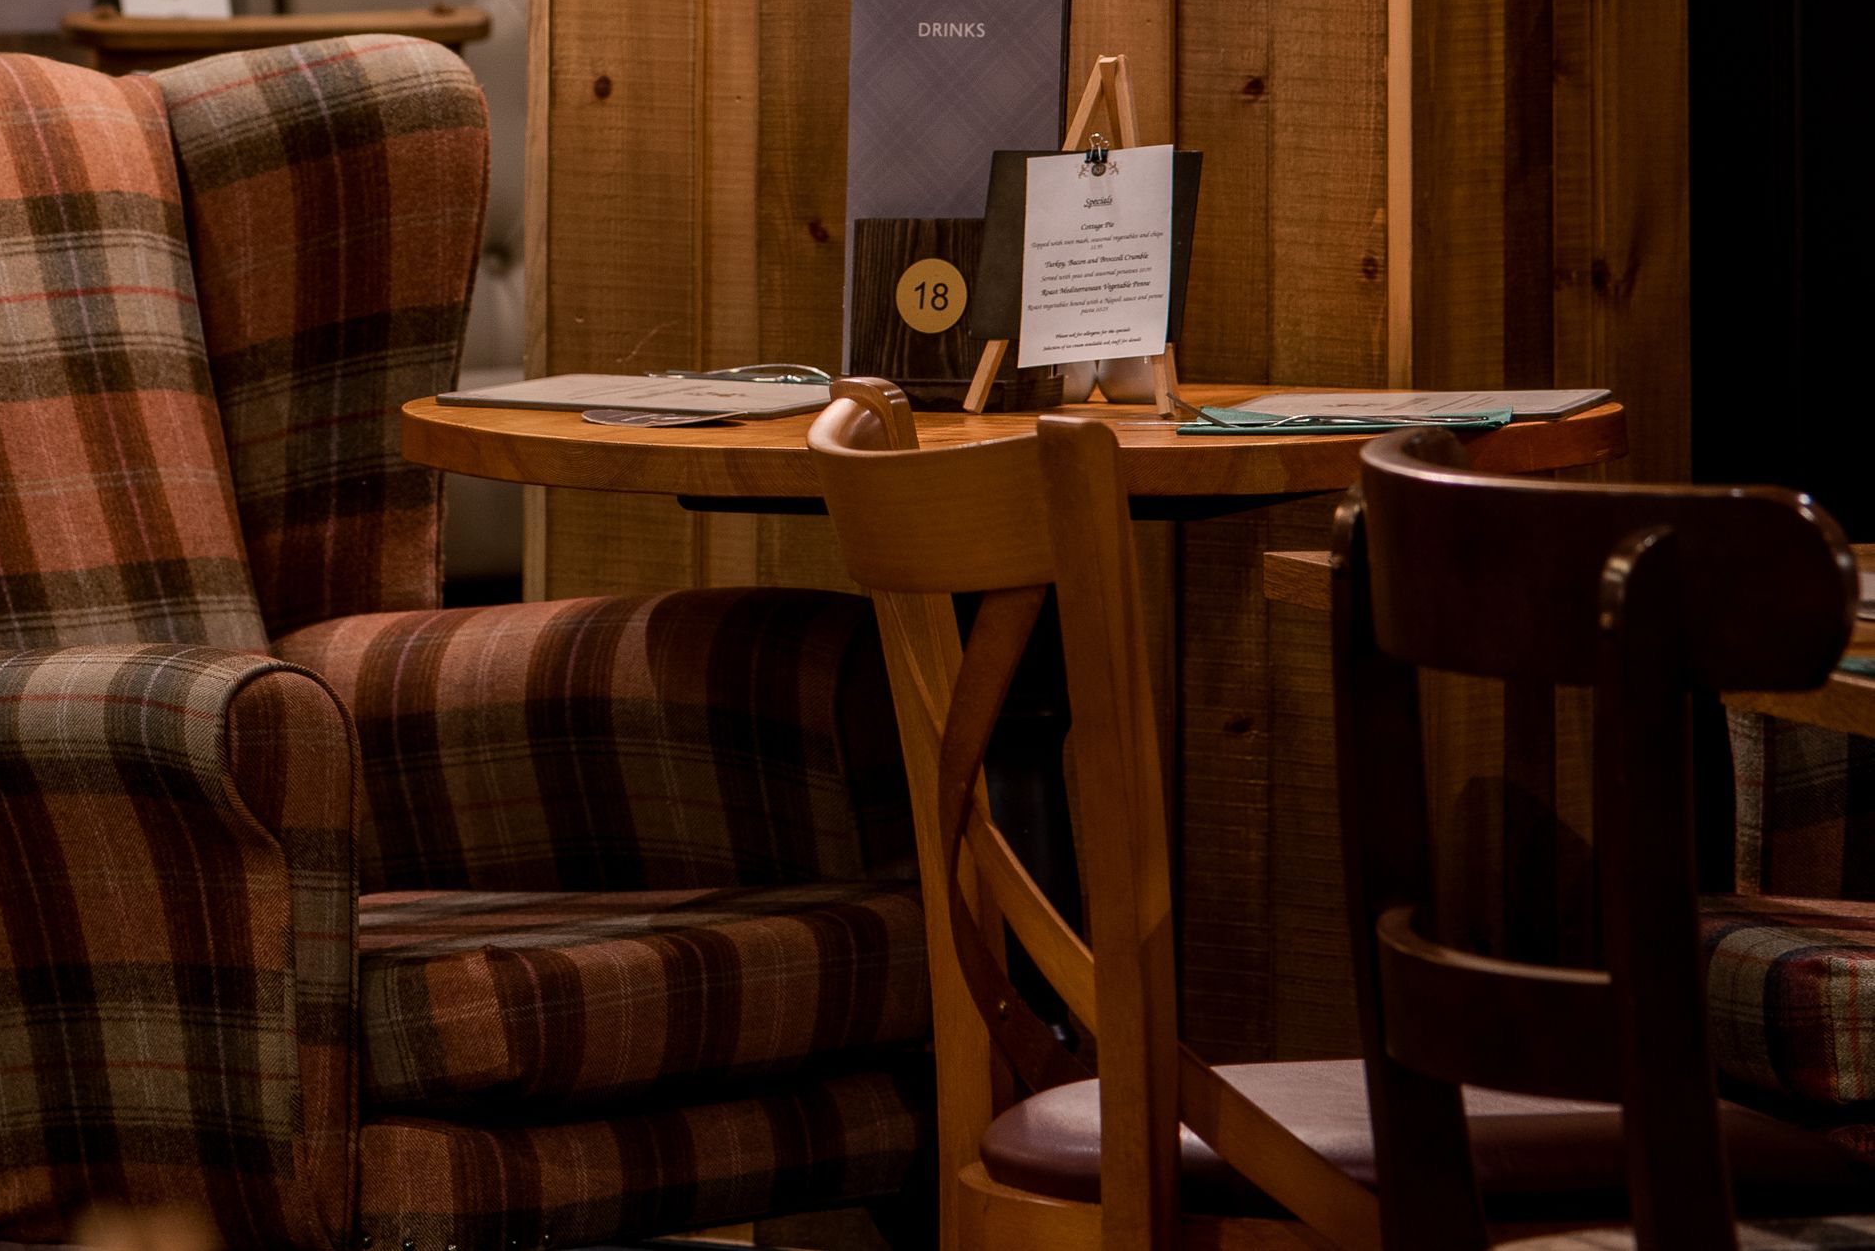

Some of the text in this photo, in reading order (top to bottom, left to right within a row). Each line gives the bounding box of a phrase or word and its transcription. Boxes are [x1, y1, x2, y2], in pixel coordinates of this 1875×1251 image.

[918, 22, 986, 38] DRINKS
[1084, 195, 1113, 209] Specials
[1081, 223, 1103, 232] Cottage
[1087, 256, 1098, 264] and
[1124, 252, 1149, 261] Crumble
[1102, 280, 1131, 292] Vegetable
[914, 281, 949, 311] 18
